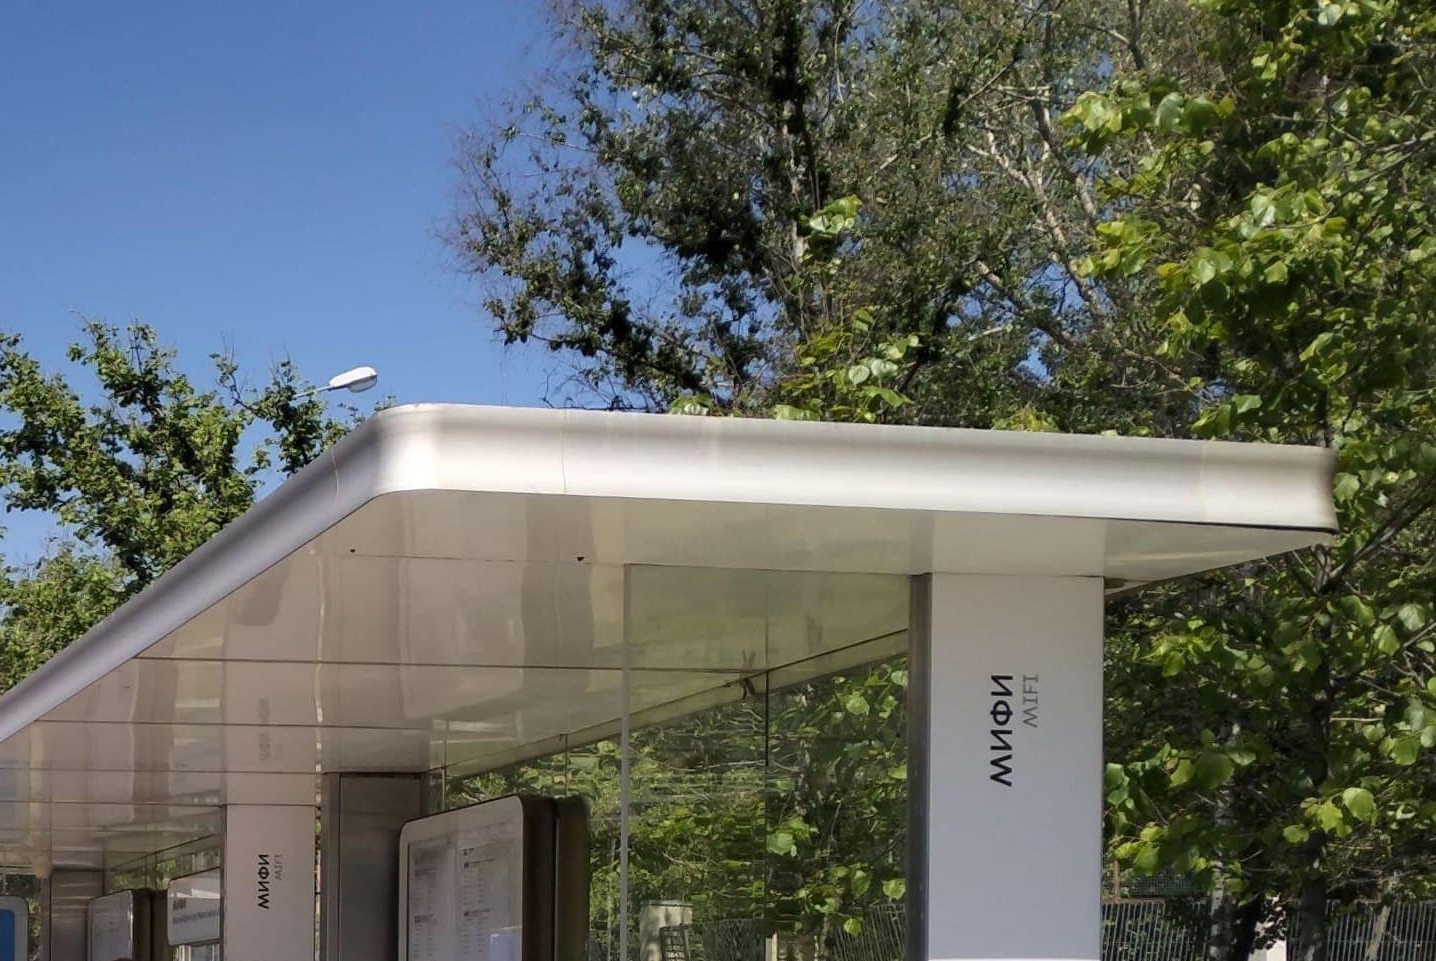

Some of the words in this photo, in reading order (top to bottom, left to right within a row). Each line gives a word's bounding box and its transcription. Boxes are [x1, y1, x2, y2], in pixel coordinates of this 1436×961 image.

[1022, 674, 1039, 728] MIFI
[989, 674, 1014, 787] МИФИ
[257, 853, 270, 910] МИФИ
